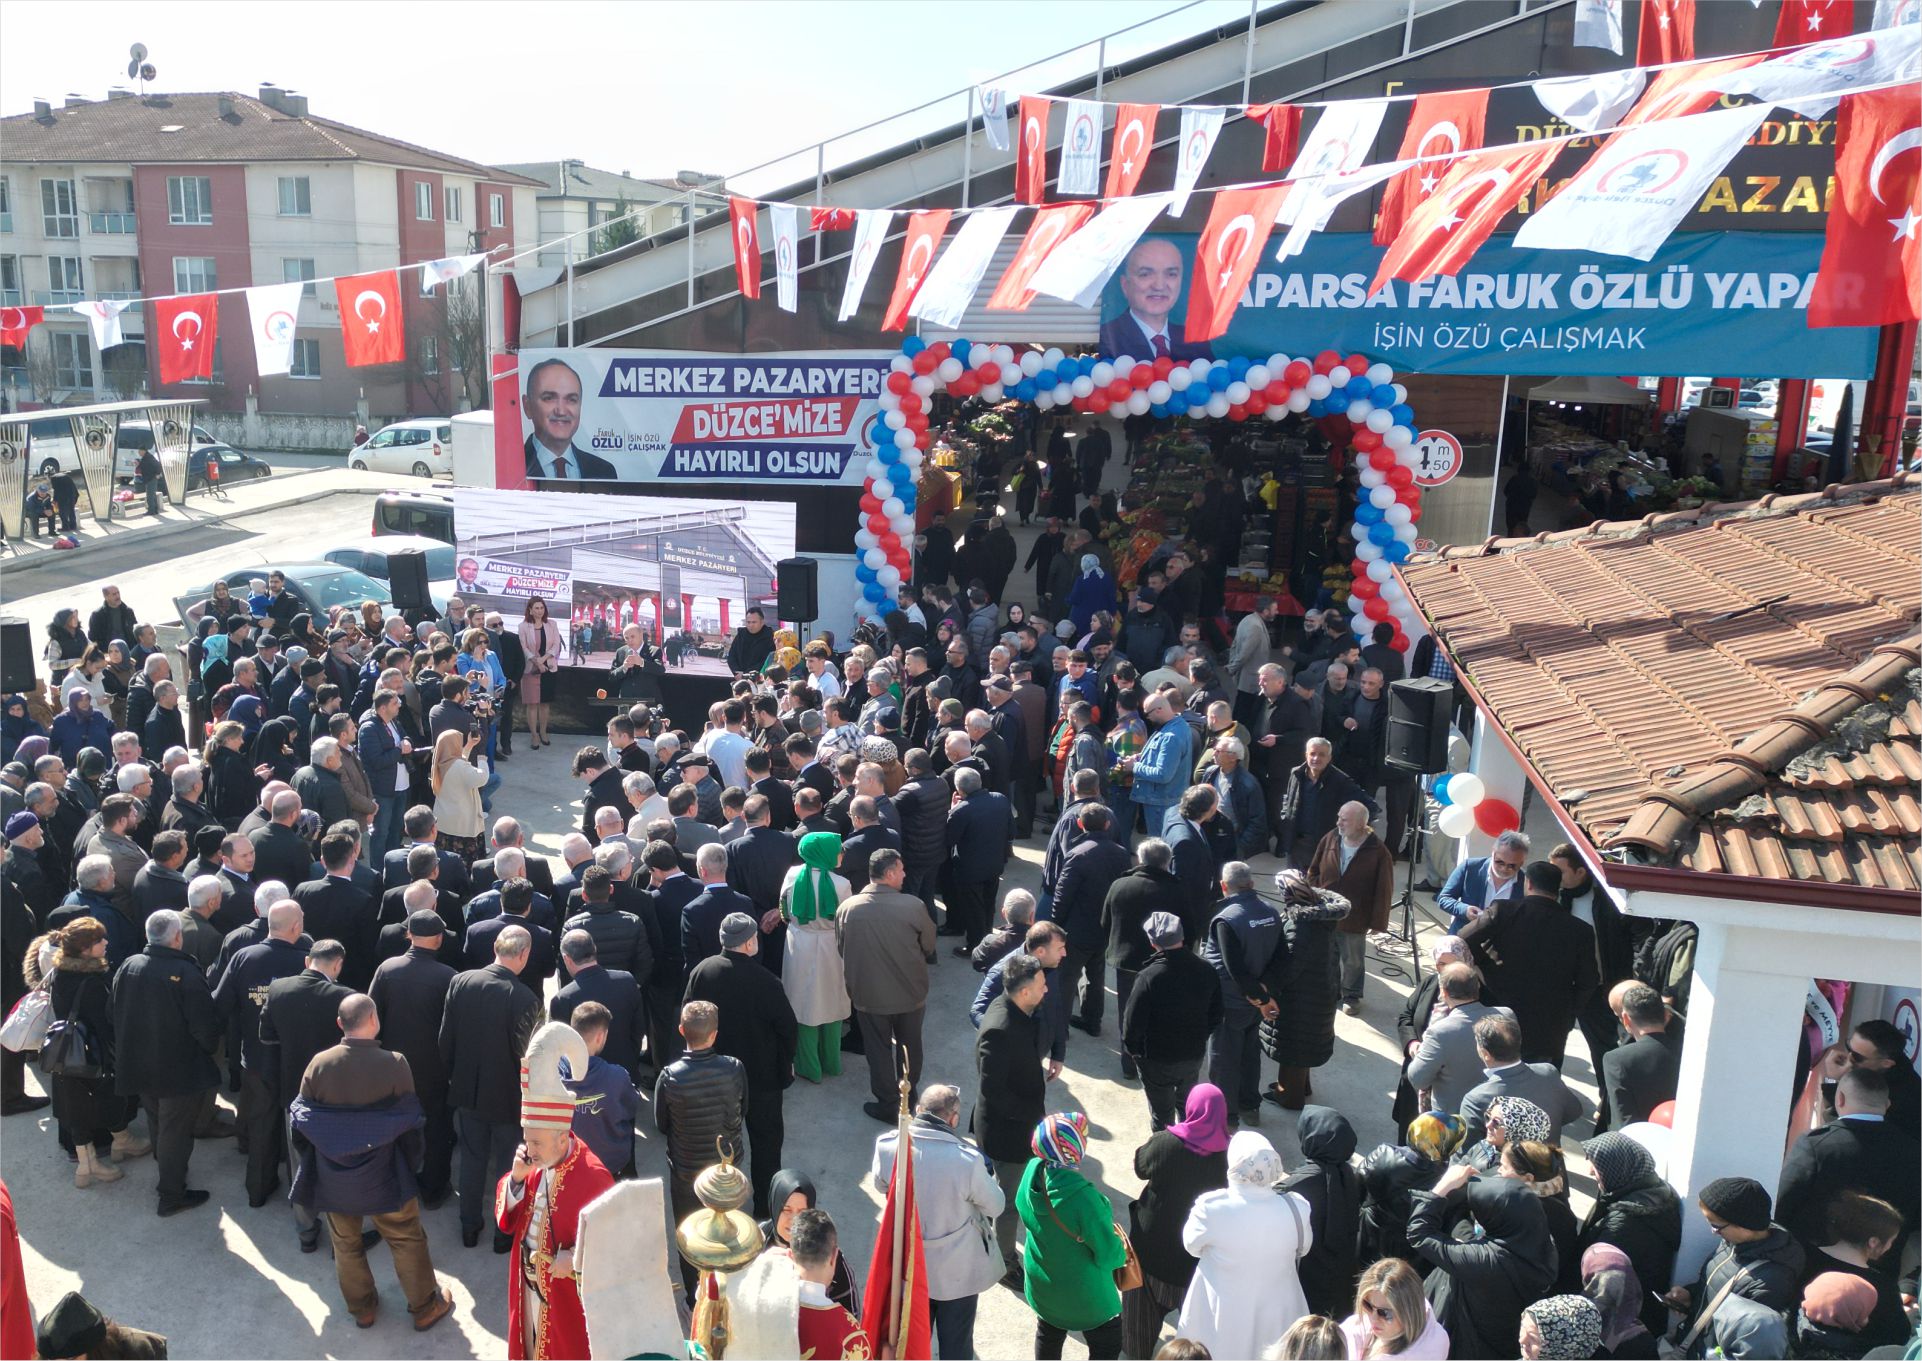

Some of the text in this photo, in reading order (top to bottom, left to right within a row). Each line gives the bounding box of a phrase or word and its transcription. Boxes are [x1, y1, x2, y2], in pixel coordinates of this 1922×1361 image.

[1407, 273, 1559, 309] FARUK
[1569, 264, 1694, 310] ÖZLÜ
[1374, 322, 1647, 352] İŞİN ÖZÜ ÇALIŞMAK
[614, 367, 726, 393] MERKEZ
[591, 434, 623, 449] ÖZLÜ
[628, 443, 666, 453] ÇALIŞMAK
[674, 450, 841, 474] HAYIRLI OLSUN
[488, 562, 522, 575] MERKEZ
